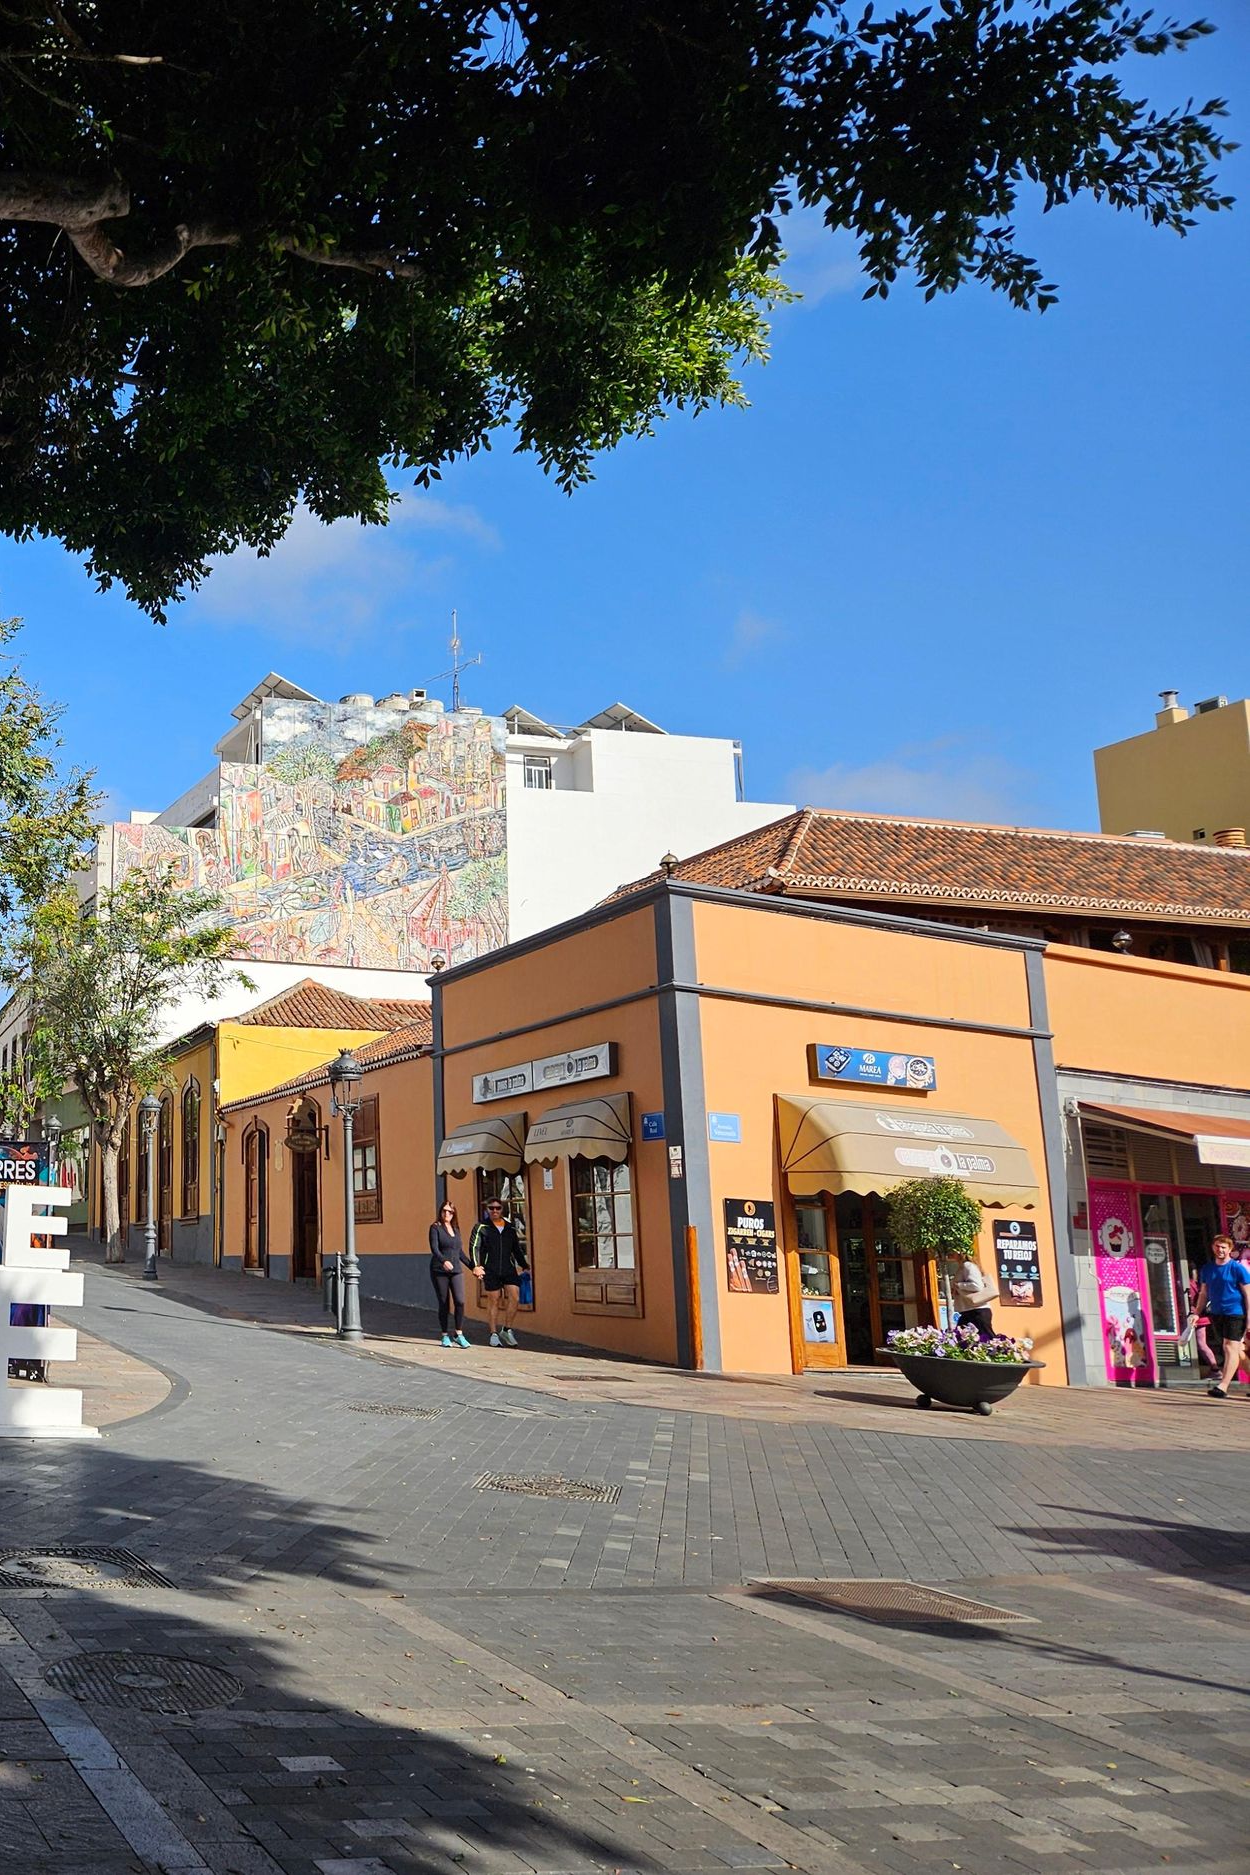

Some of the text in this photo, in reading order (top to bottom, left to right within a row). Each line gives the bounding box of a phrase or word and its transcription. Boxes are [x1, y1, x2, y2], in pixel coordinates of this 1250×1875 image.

[859, 1064, 881, 1075] MAREA
[956, 1152, 966, 1169] la
[966, 1155, 991, 1173] palma
[737, 1216, 764, 1229] PUROS
[756, 1229, 775, 1239] CIGARS
[996, 1238, 1037, 1251] REPARAMOS
[1003, 1249, 1033, 1261] TU RELOJ
